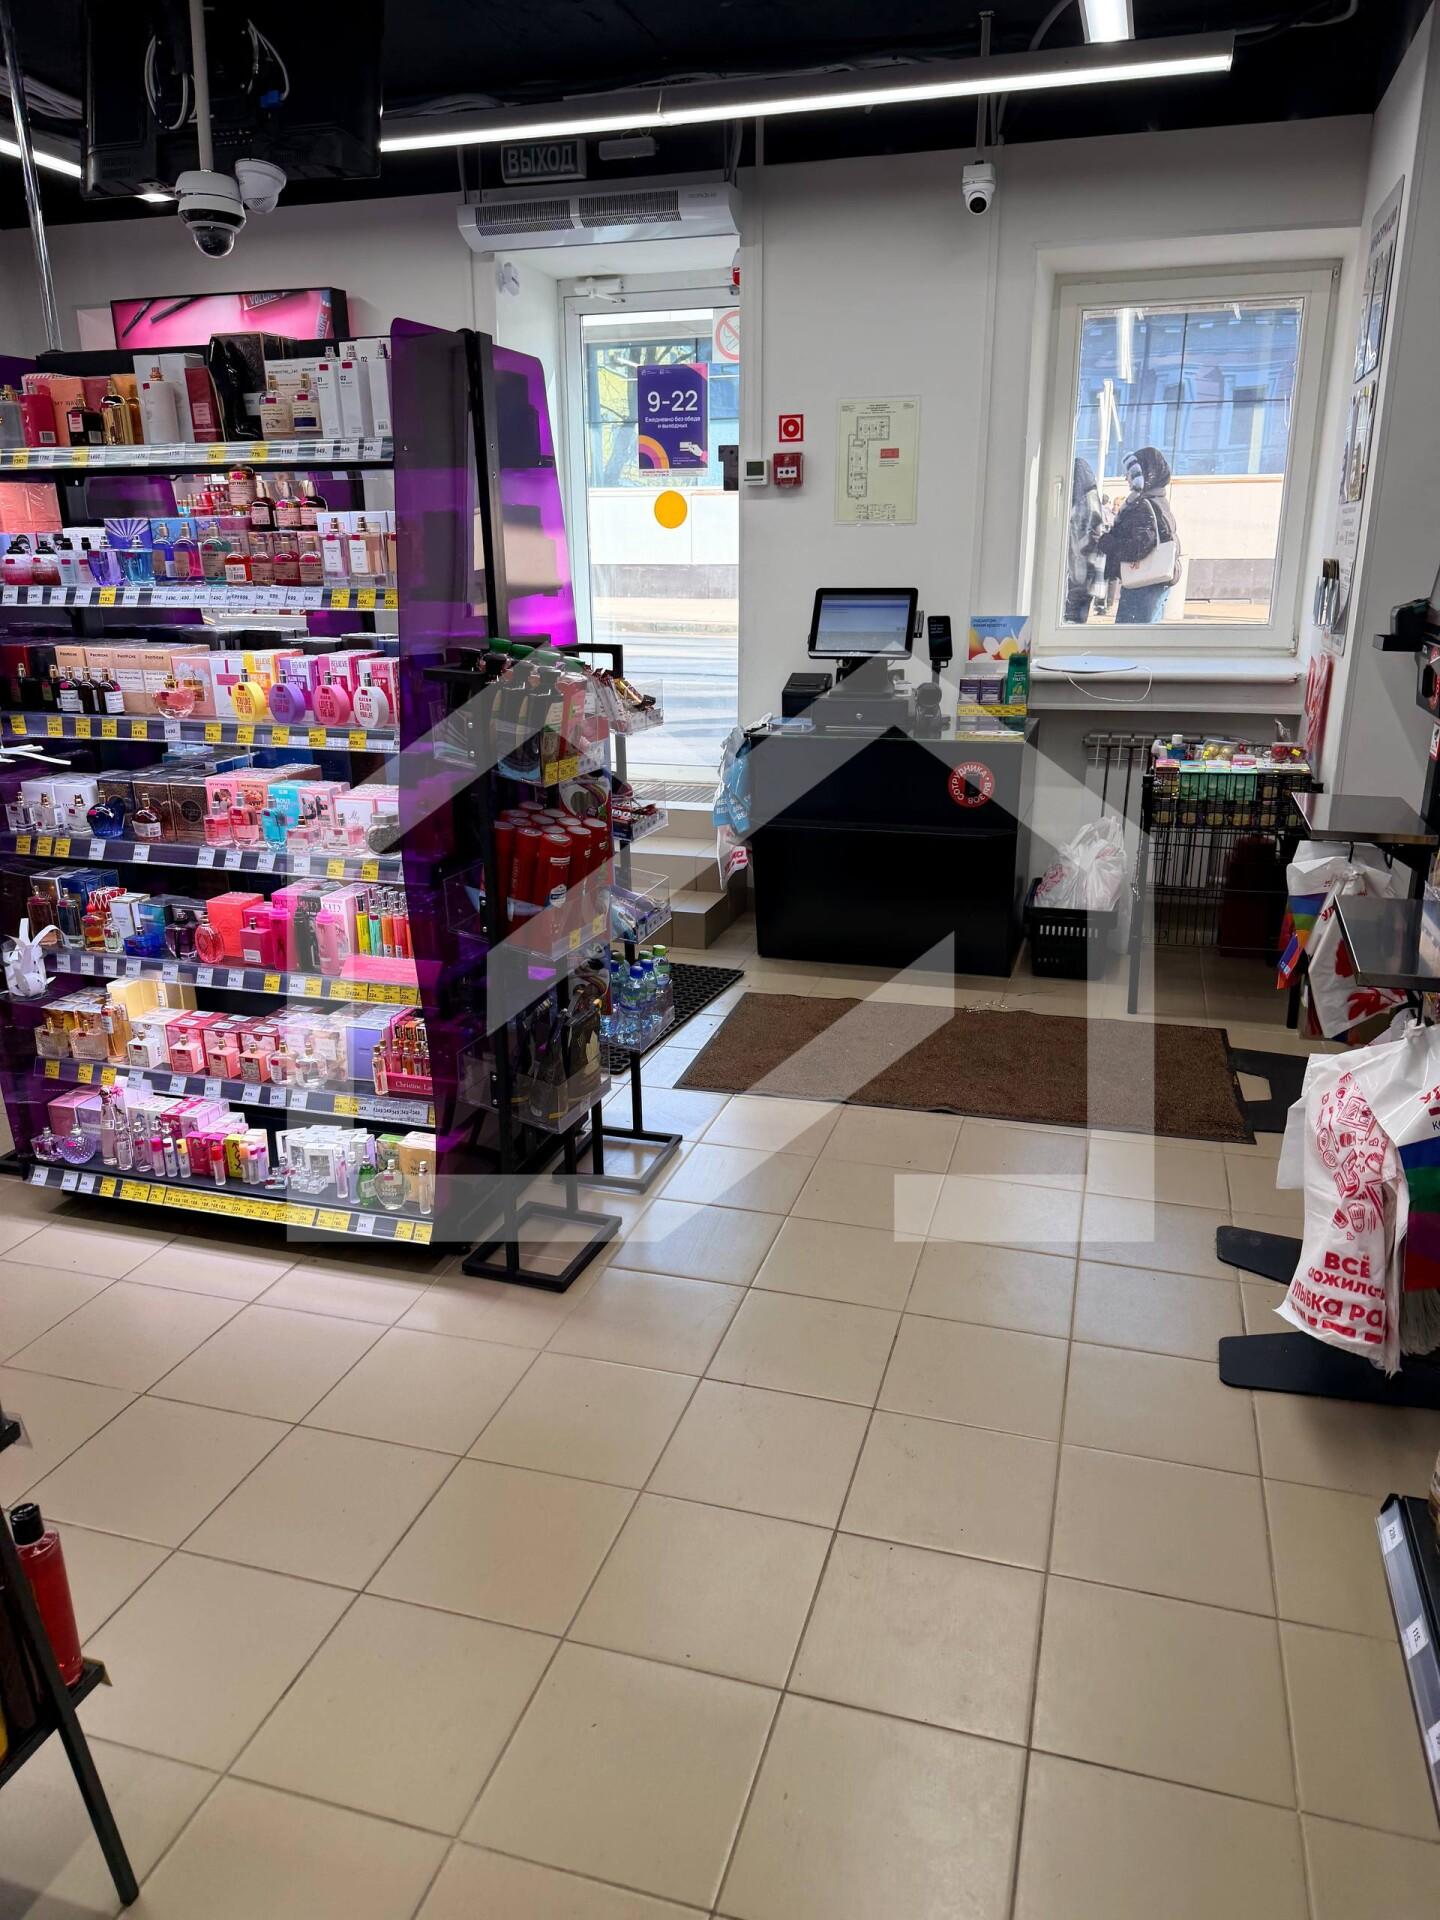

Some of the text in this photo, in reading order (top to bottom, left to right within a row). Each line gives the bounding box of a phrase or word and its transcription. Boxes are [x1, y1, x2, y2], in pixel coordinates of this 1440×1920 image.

[507, 145, 576, 174] ВЫХОД
[648, 390, 698, 412] 9-22
[951, 764, 992, 804] ВЫЗОВ СОТРУДНИКА
[1324, 1251, 1370, 1278] ВСЁ
